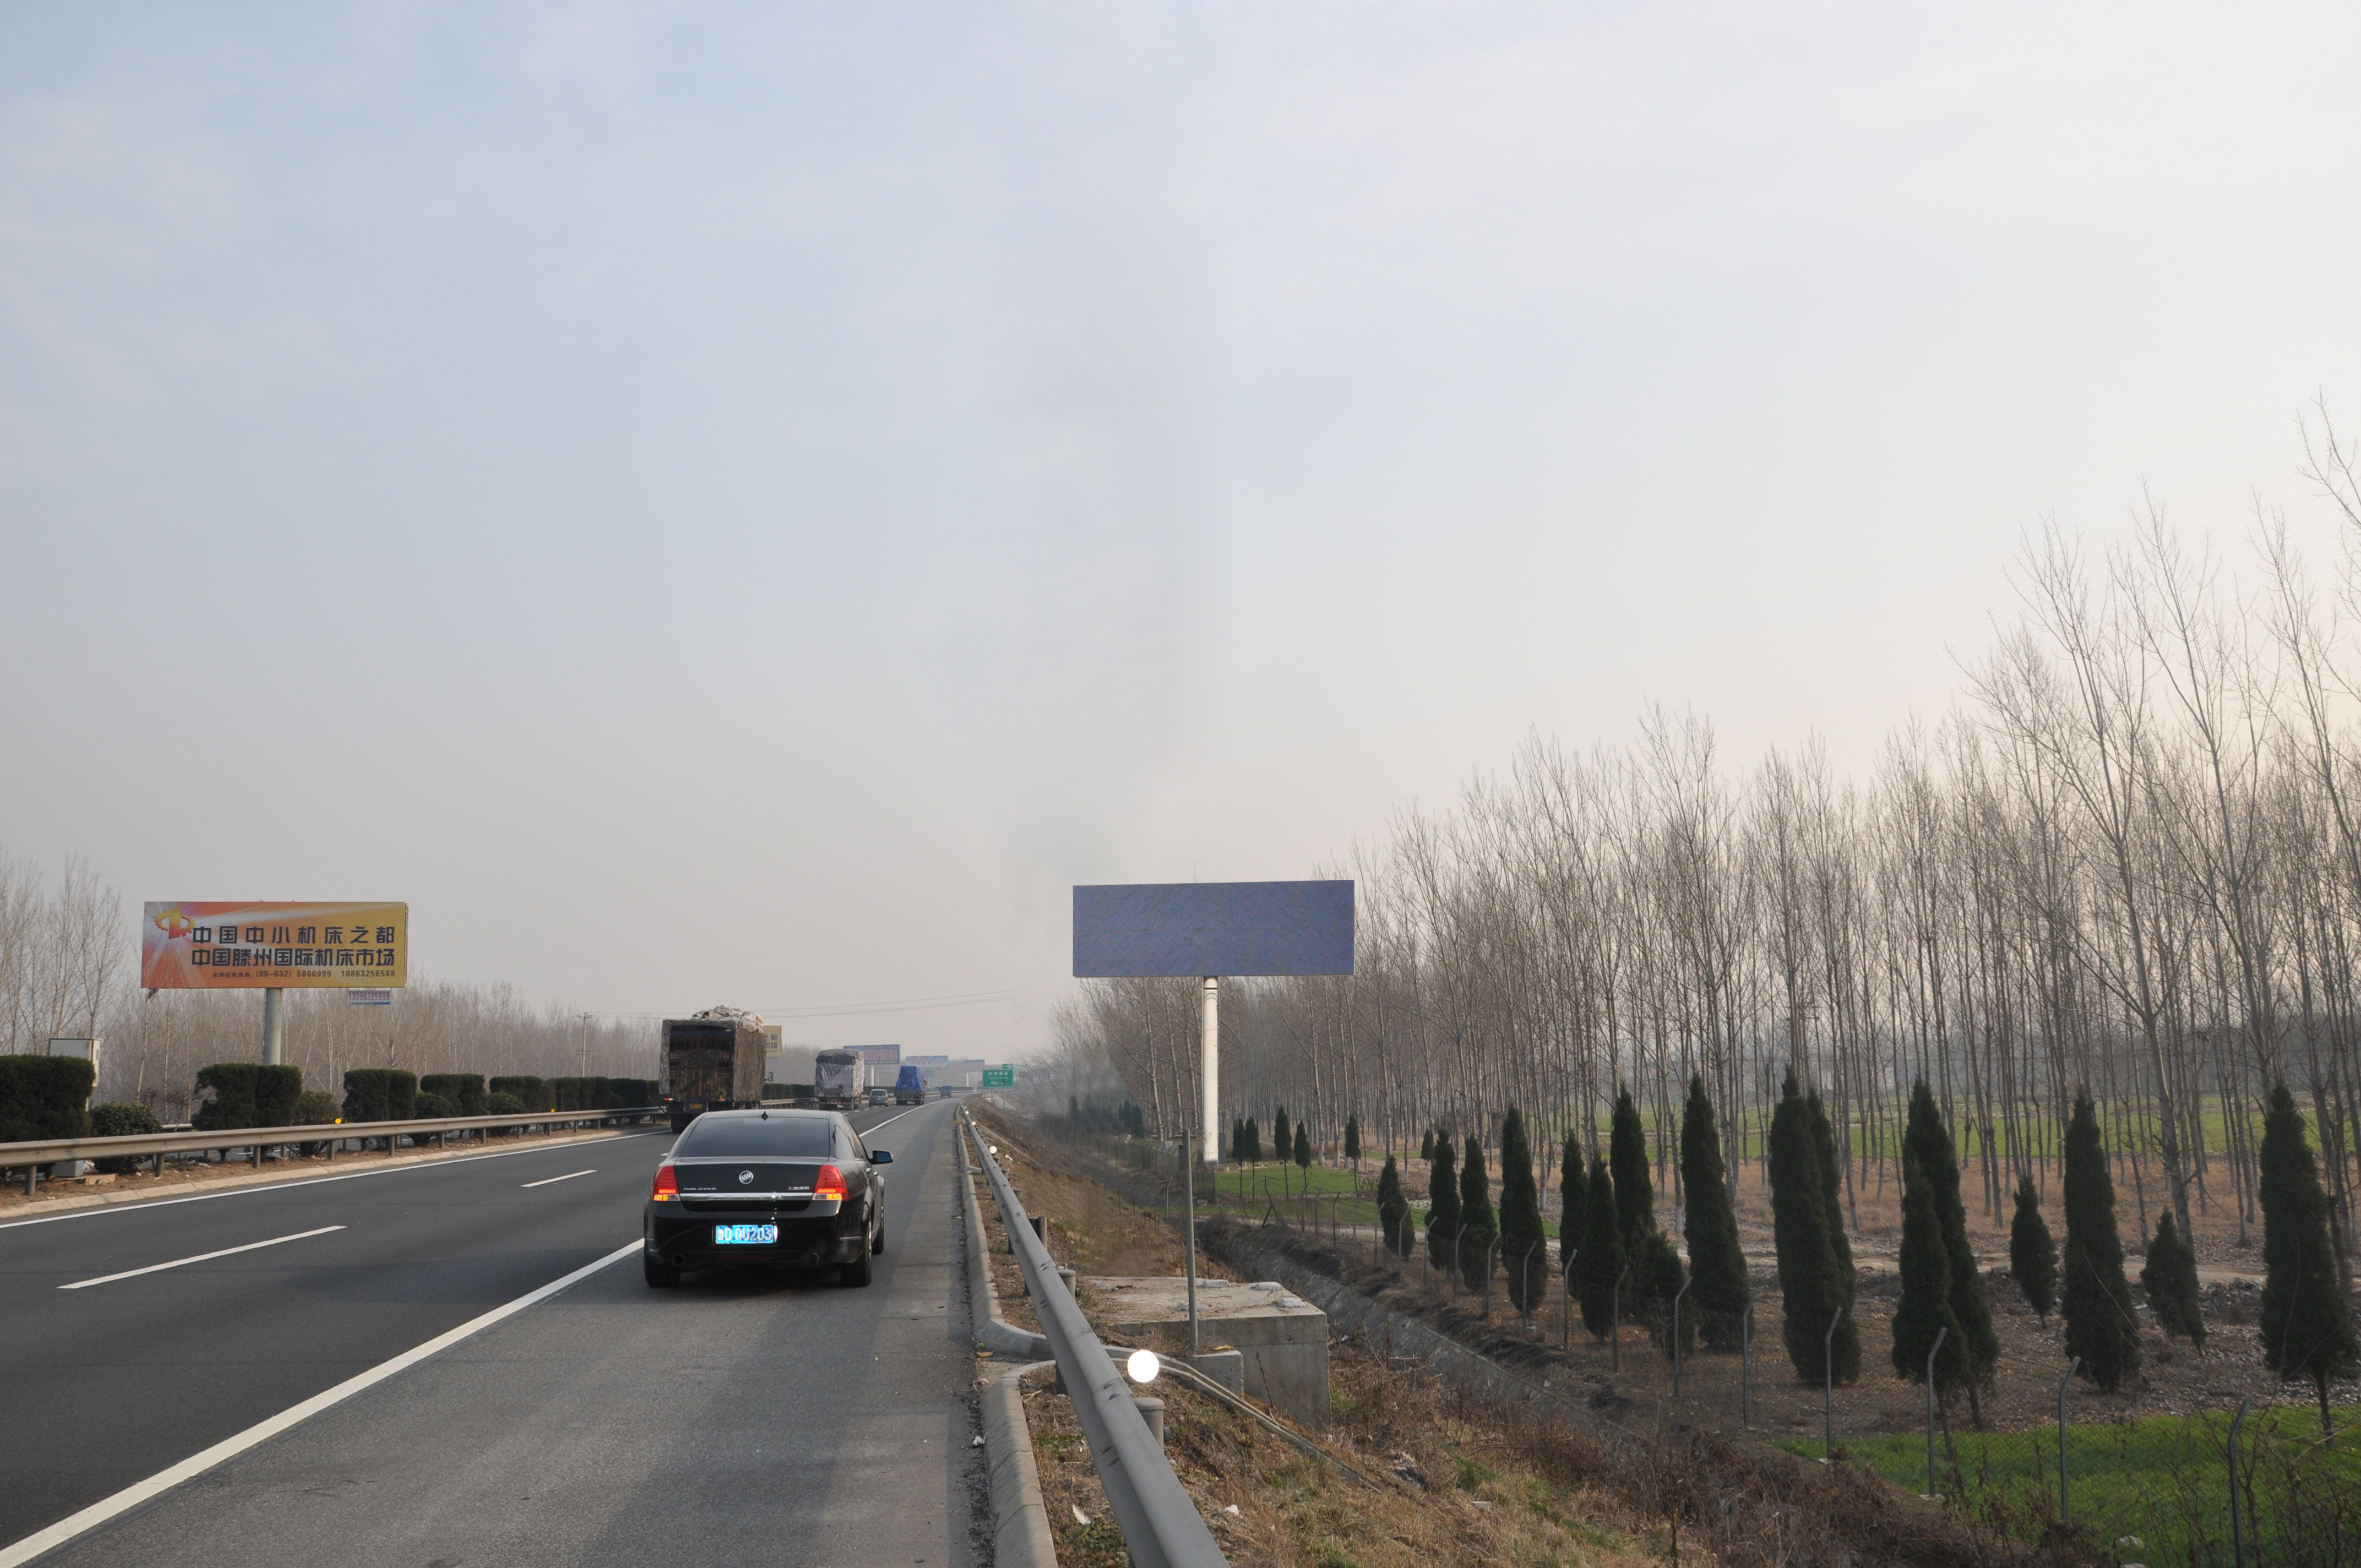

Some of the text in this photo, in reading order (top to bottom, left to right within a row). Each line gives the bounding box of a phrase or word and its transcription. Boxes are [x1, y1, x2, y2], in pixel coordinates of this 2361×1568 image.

[193, 926, 395, 944] 中国中小机床之都
[192, 948, 395, 966] 中国滕州国际机床市场
[348, 992, 390, 1001] 13396329999
